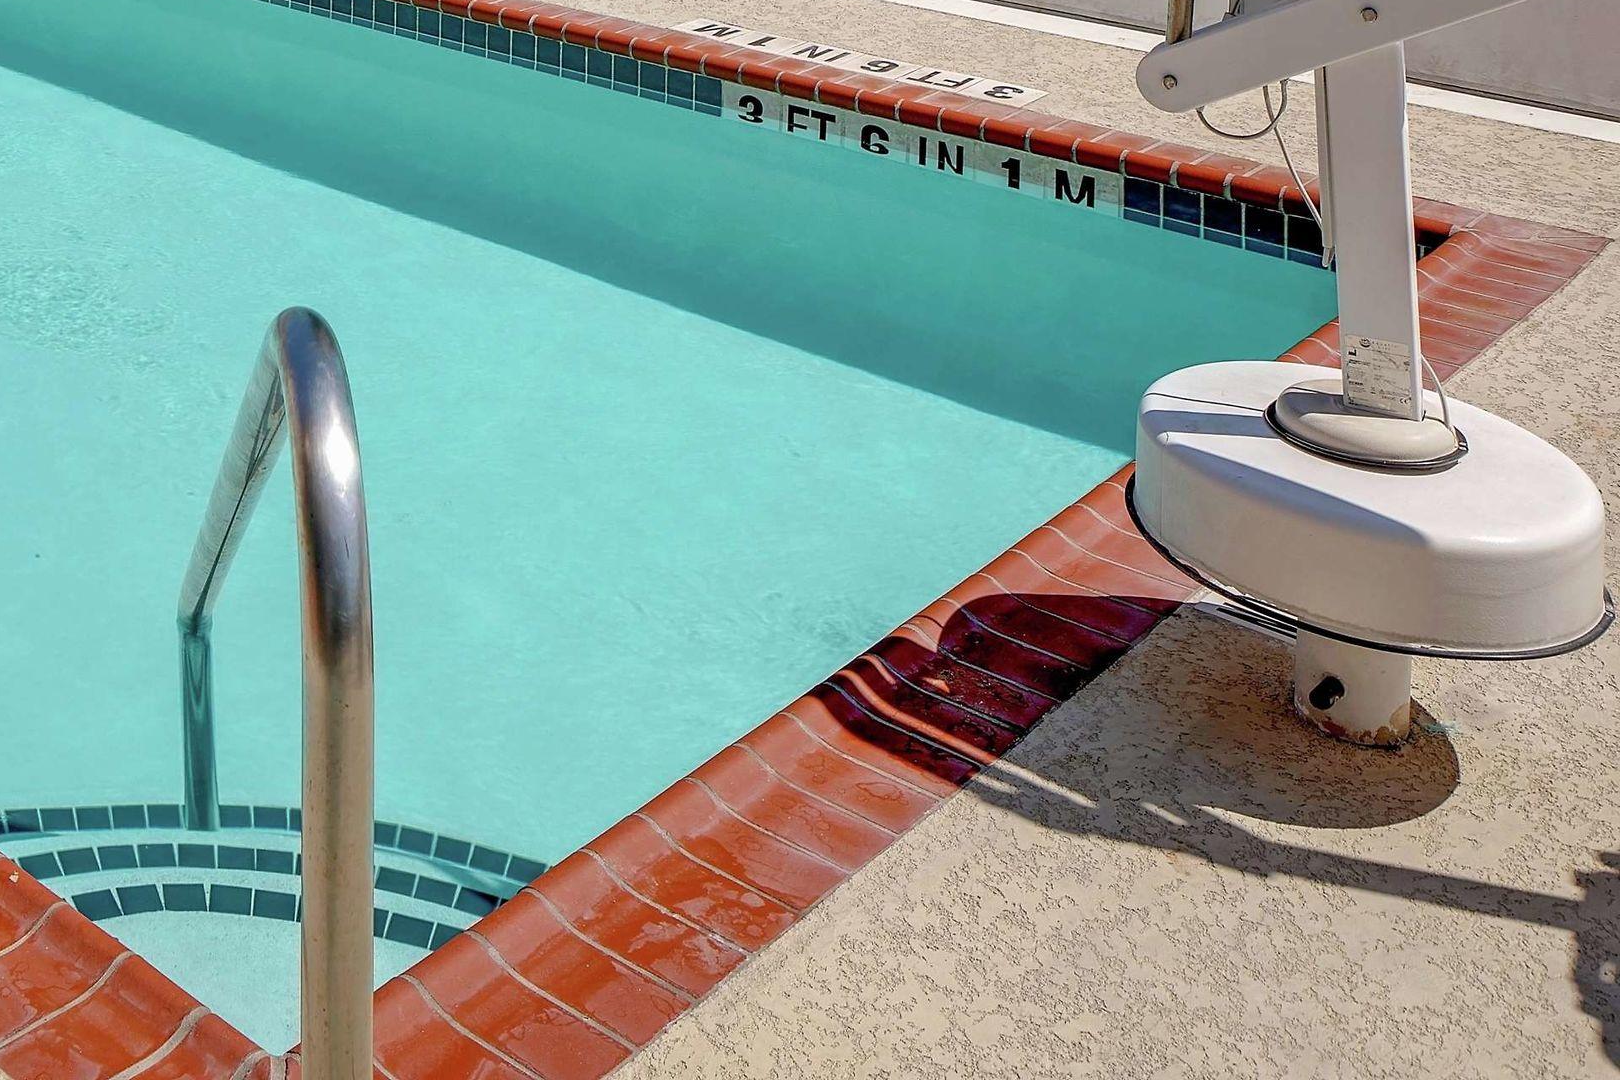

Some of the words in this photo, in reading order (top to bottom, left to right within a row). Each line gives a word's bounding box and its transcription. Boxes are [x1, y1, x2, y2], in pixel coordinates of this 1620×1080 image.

[692, 23, 733, 38] M
[747, 35, 778, 47] 1
[792, 41, 853, 62] IN
[860, 60, 900, 73] 6
[906, 70, 976, 89] FT
[983, 85, 1025, 100] 3
[737, 94, 765, 124] 3
[786, 104, 837, 141] FT
[860, 123, 890, 156] 6
[917, 137, 965, 176] IN
[1001, 157, 1022, 190] 1
[1055, 169, 1096, 209] M
